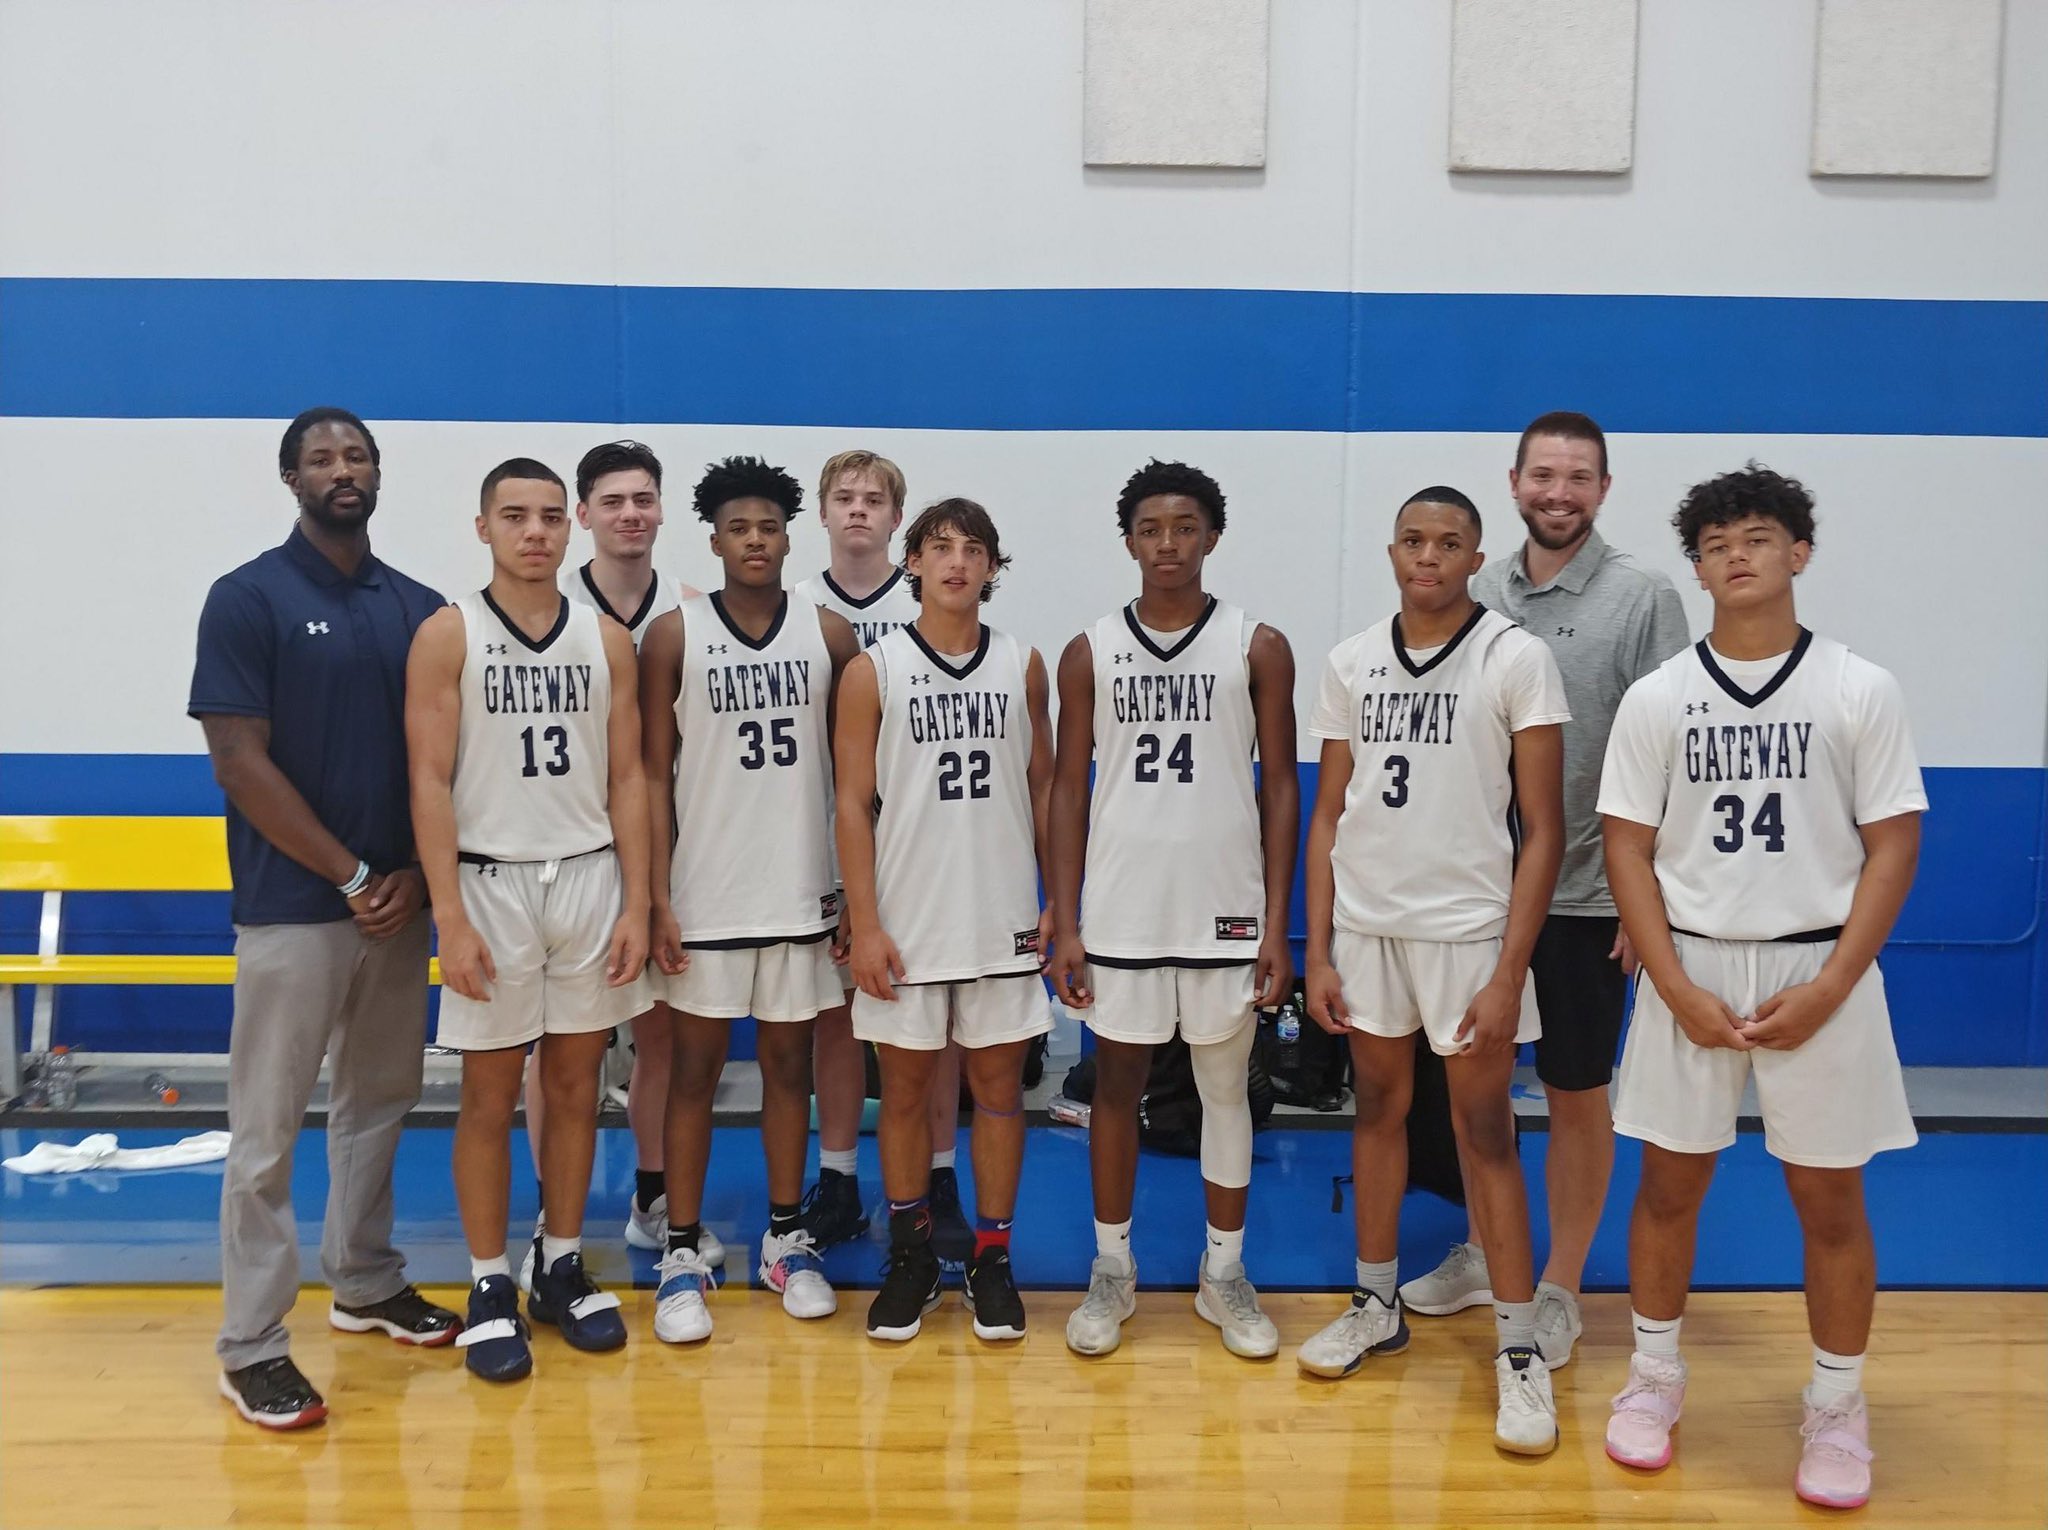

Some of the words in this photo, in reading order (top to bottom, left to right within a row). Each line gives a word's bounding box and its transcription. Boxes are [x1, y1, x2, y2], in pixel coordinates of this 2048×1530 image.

[484, 664, 591, 715] GATEWAY
[707, 660, 810, 714] GATEWAY
[1113, 673, 1216, 724] GATEWAY
[737, 717, 798, 771] 35
[909, 691, 1009, 745] GATEWAY
[1361, 691, 1459, 745] GATEWAY
[520, 725, 571, 778] 13
[938, 749, 991, 801] 22
[1134, 732, 1194, 784] 24
[1685, 722, 1812, 784] GATEWAY
[1381, 754, 1410, 809] 3
[1712, 792, 1785, 854] 34
